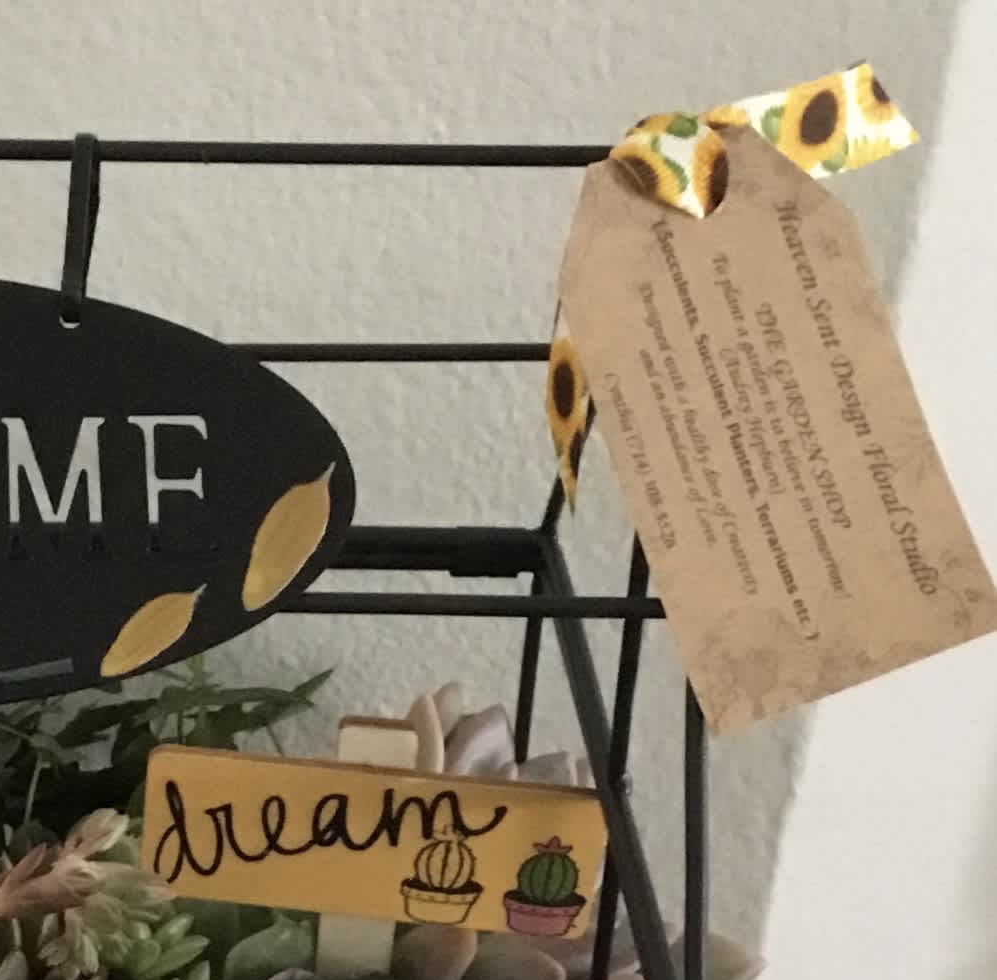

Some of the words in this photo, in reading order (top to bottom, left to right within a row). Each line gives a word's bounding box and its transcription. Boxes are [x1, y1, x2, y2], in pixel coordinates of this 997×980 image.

[693, 332, 733, 420] Succulent
[754, 501, 799, 595] Terrariums
[772, 197, 818, 292] Heaven
[805, 296, 842, 351] Sent
[828, 353, 872, 438] Design
[862, 442, 914, 516] Floral
[889, 519, 945, 596] Studio
[154, 779, 507, 883] dream
